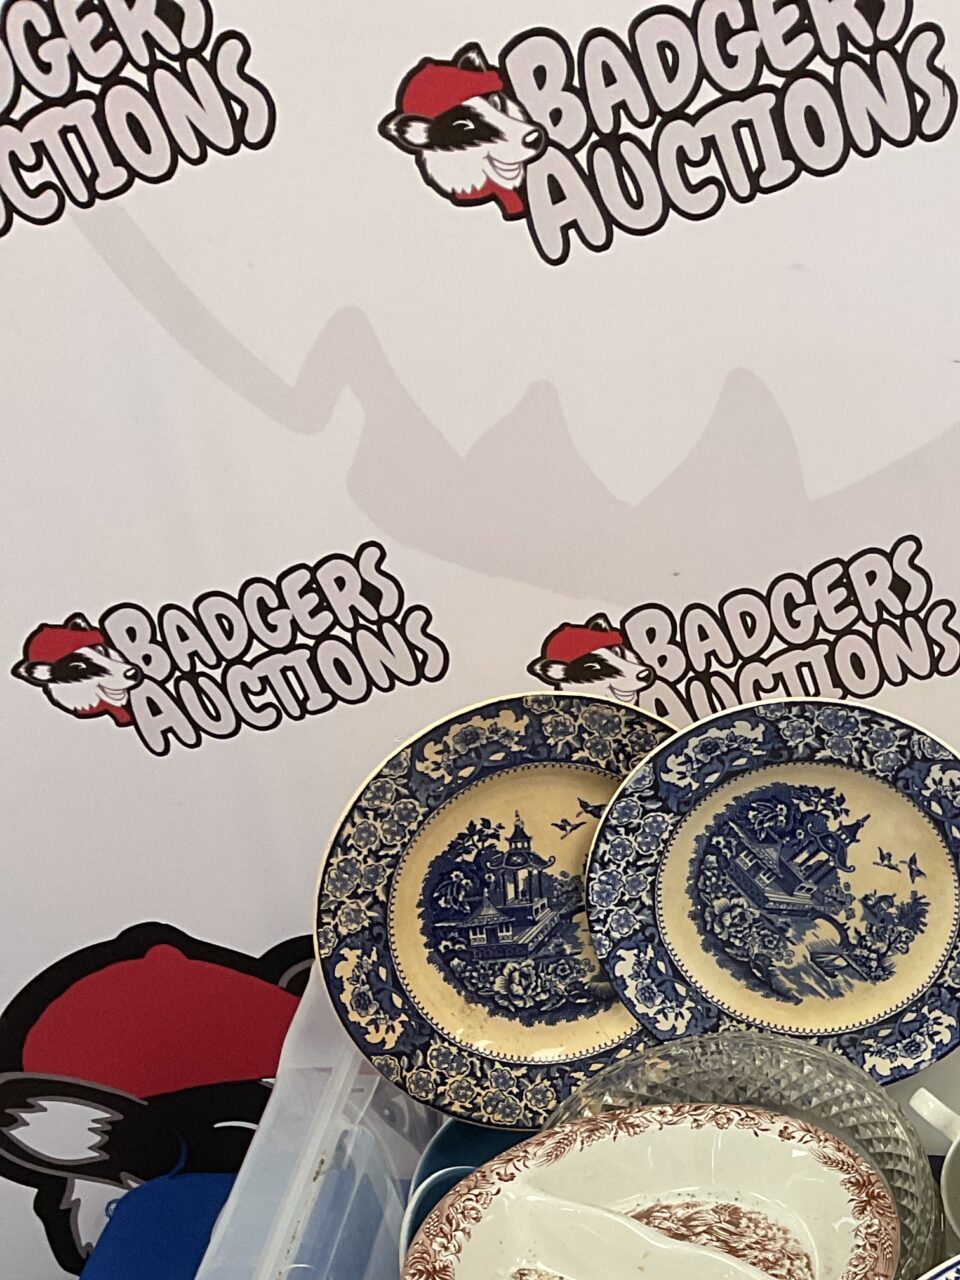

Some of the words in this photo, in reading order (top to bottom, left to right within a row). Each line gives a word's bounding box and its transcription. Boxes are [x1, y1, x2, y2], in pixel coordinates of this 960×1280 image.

[0, 29, 276, 237] CTIONS
[525, 21, 958, 266] AUCTIONS
[101, 541, 404, 682] BADGERS
[127, 604, 451, 756] AUCTIONS
[620, 534, 933, 684] BADGERS
